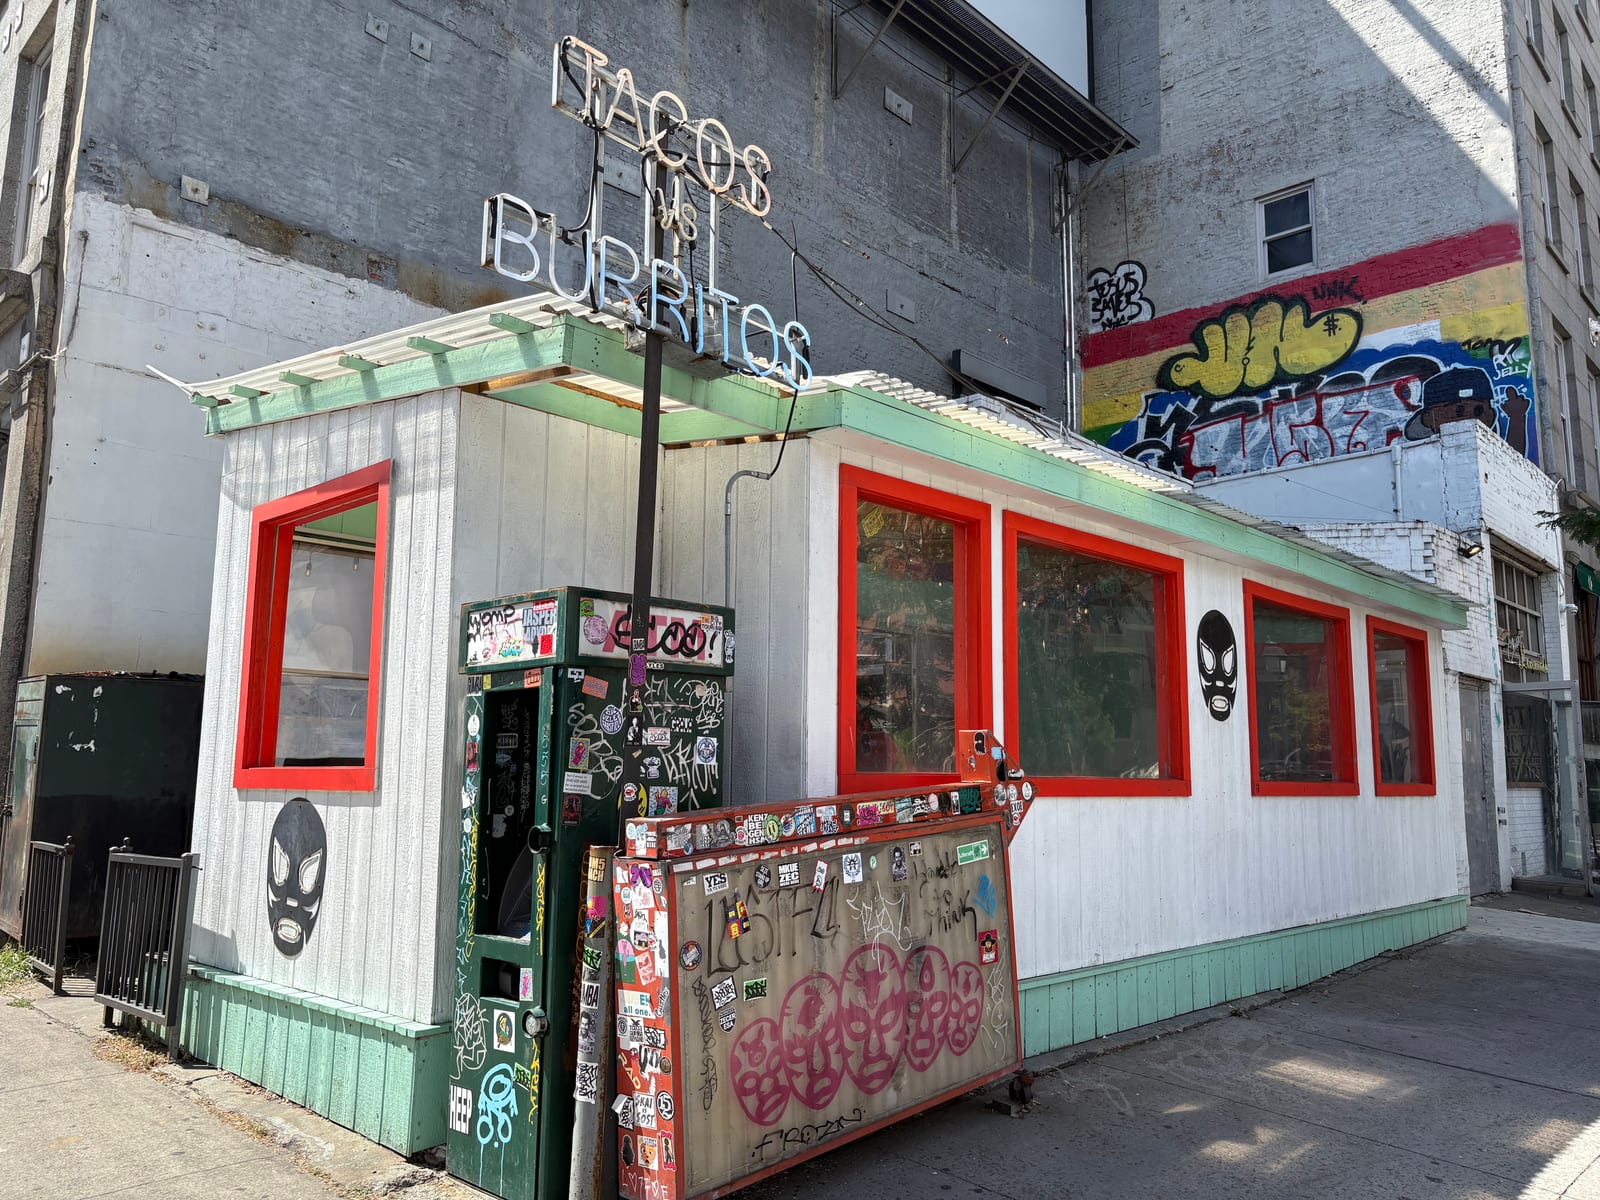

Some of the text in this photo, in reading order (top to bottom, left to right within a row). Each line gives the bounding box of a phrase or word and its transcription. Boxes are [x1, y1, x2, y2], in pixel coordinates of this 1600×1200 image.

[565, 35, 772, 217] TACOS
[493, 192, 813, 391] BURRITOS
[1493, 361, 1533, 380] JELLY
[705, 873, 727, 888] YES
[779, 871, 799, 882] ZEC
[623, 1005, 634, 1014] all
